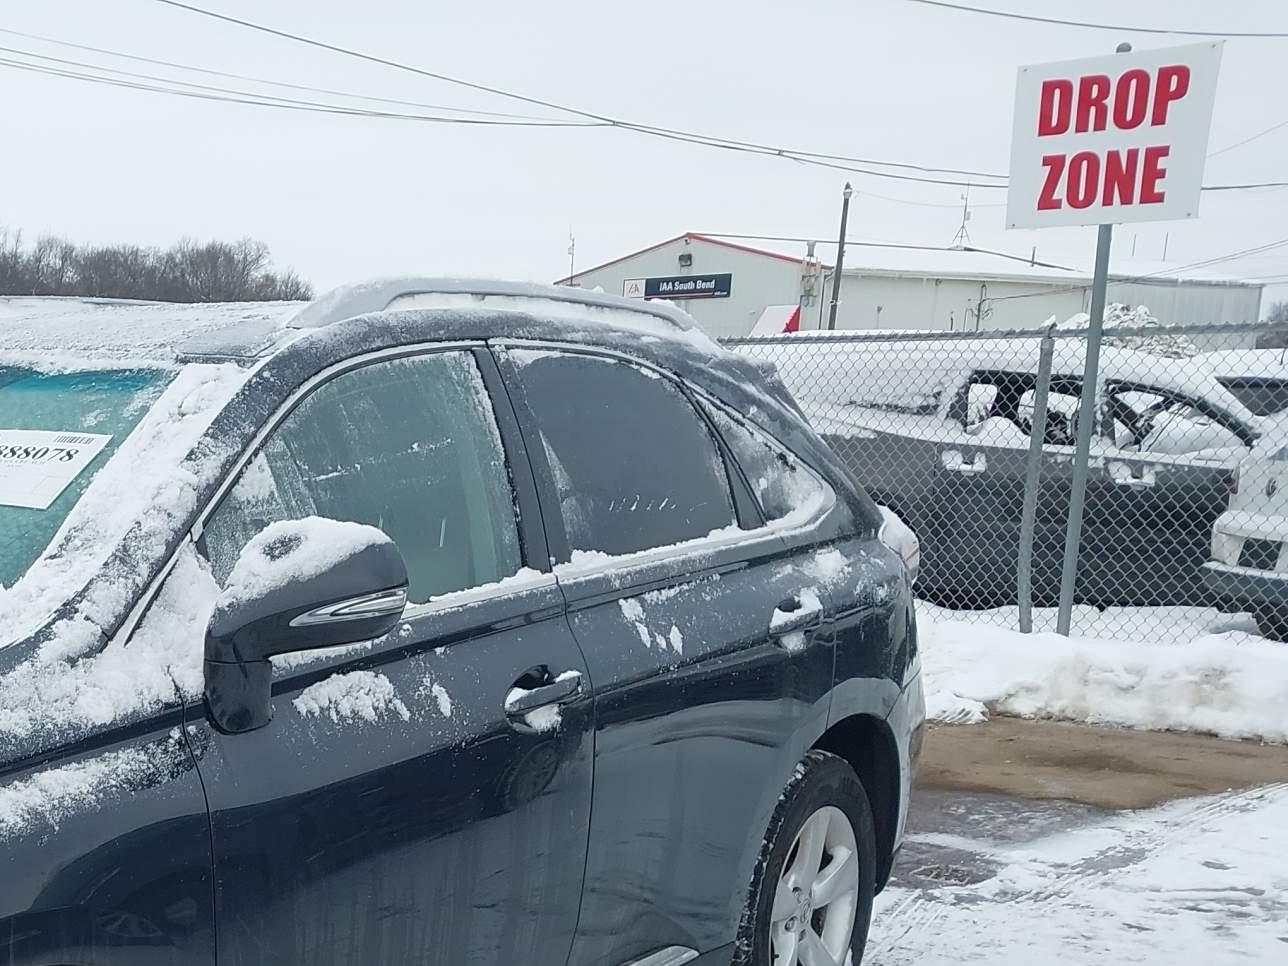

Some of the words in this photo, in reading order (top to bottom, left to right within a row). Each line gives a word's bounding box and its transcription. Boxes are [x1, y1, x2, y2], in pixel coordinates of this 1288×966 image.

[1037, 65, 1191, 138] DROP
[1036, 145, 1171, 211] ZONE
[659, 281, 673, 292] IAA
[674, 280, 695, 291] South
[696, 279, 716, 289] Bend
